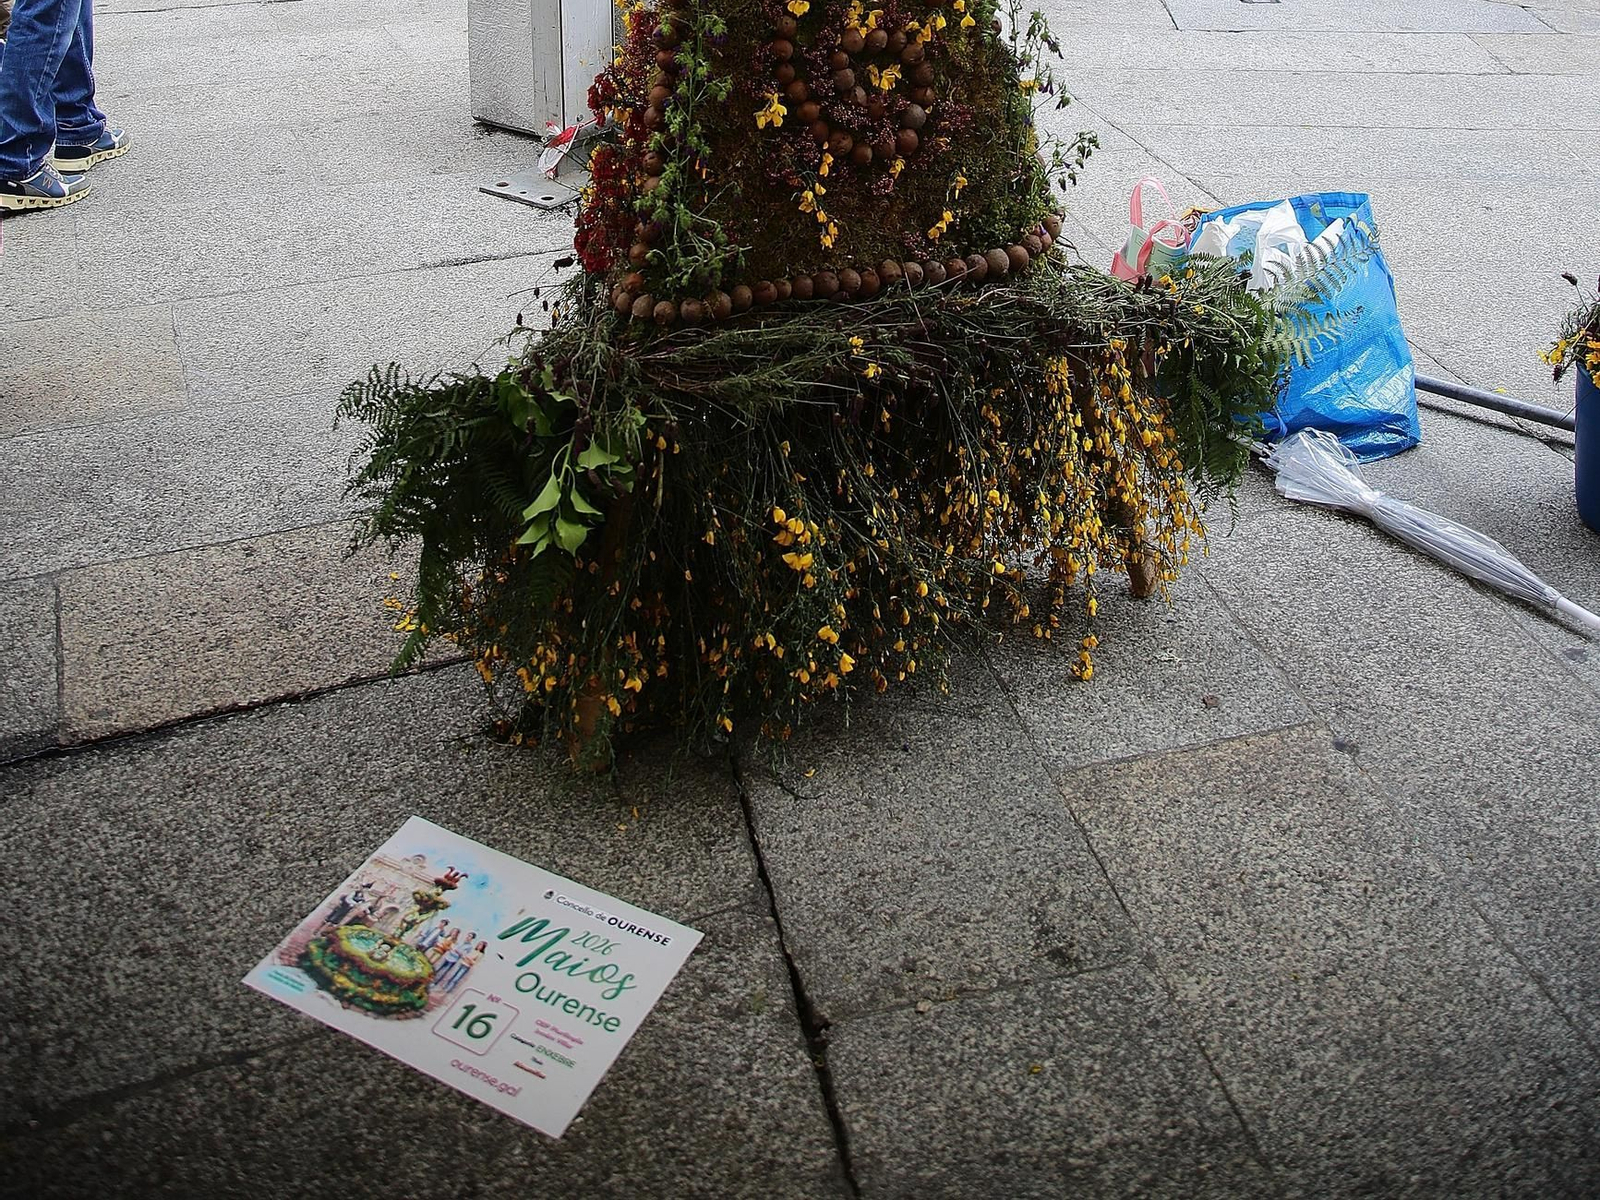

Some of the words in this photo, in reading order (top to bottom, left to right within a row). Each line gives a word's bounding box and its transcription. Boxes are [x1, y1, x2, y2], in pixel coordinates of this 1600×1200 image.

[556, 894, 594, 917] Concello
[595, 910, 608, 922] de
[607, 916, 672, 947] OURENSE
[570, 930, 621, 956] 2026
[498, 916, 637, 1000] Maios
[452, 1004, 497, 1039] 16
[515, 972, 621, 1033] Ourense
[450, 1059, 523, 1097] ourense.gal
